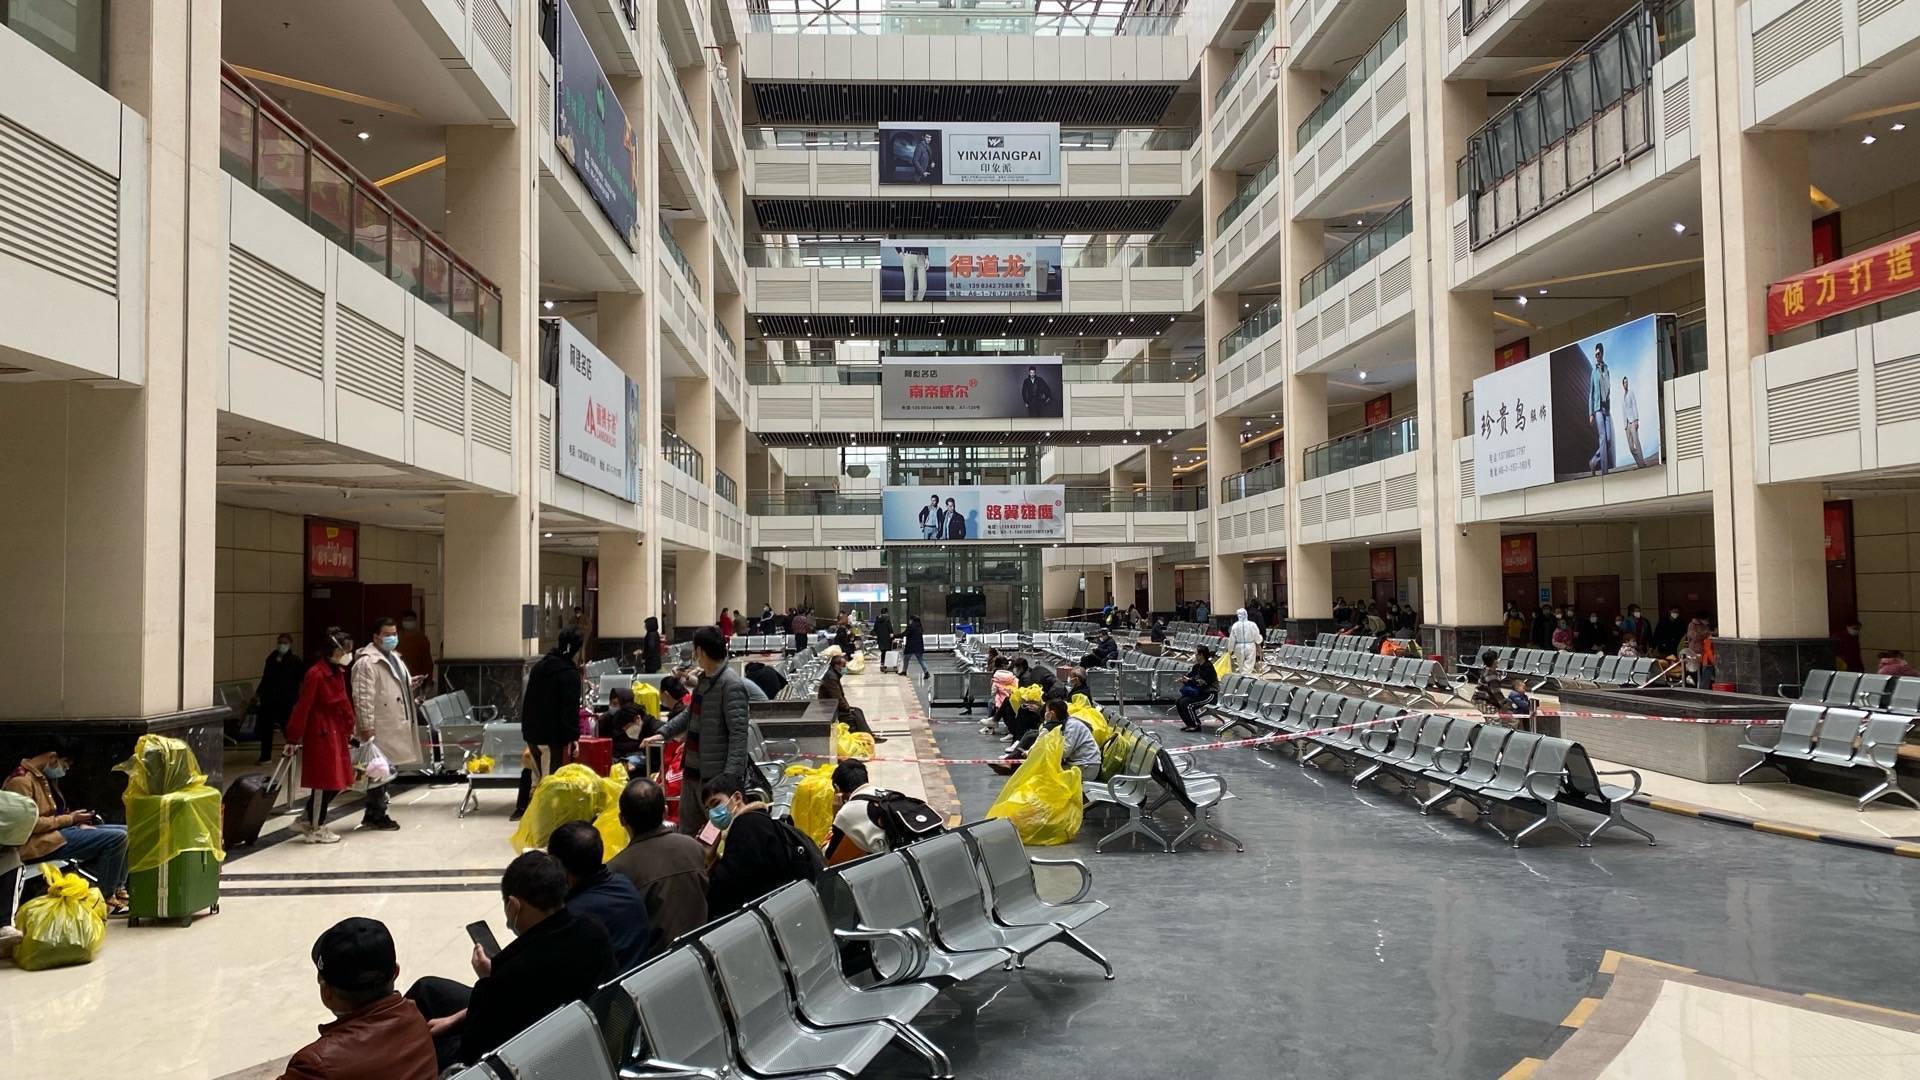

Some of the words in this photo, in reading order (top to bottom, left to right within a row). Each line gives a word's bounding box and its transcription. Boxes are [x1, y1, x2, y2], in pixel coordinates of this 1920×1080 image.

[957, 151, 1041, 161] YINXIANGPAI
[980, 162, 1012, 173] 印象派
[950, 254, 1026, 278] 得道龙
[1782, 242, 1915, 317] 倾力打造
[1480, 397, 1527, 440] 珍贵鸟
